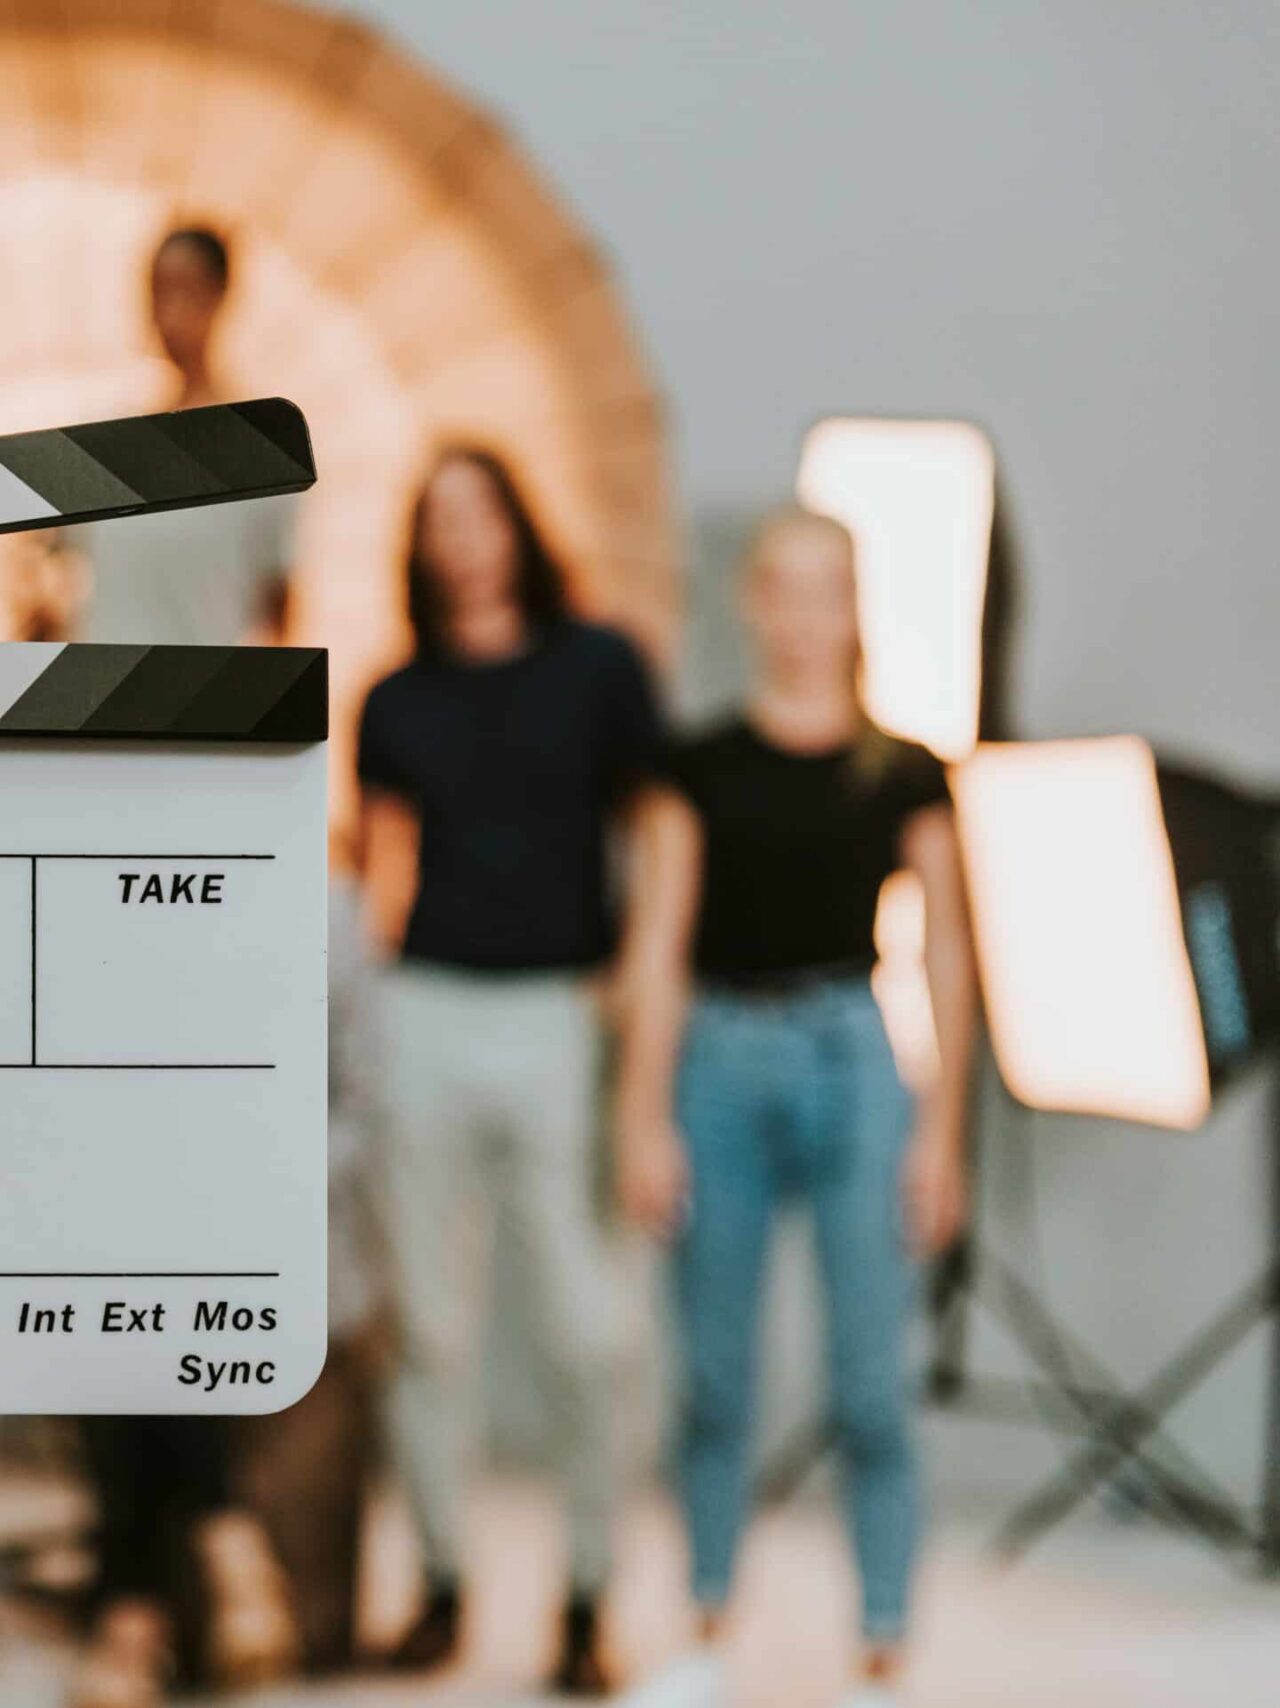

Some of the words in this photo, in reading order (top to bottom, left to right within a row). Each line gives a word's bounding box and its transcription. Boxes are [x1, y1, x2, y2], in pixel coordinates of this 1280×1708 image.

[117, 872, 226, 905] TAKE
[17, 1301, 77, 1334] Int
[100, 1300, 167, 1334] Ext
[192, 1300, 278, 1333] Mos
[176, 1353, 277, 1393] Sync
